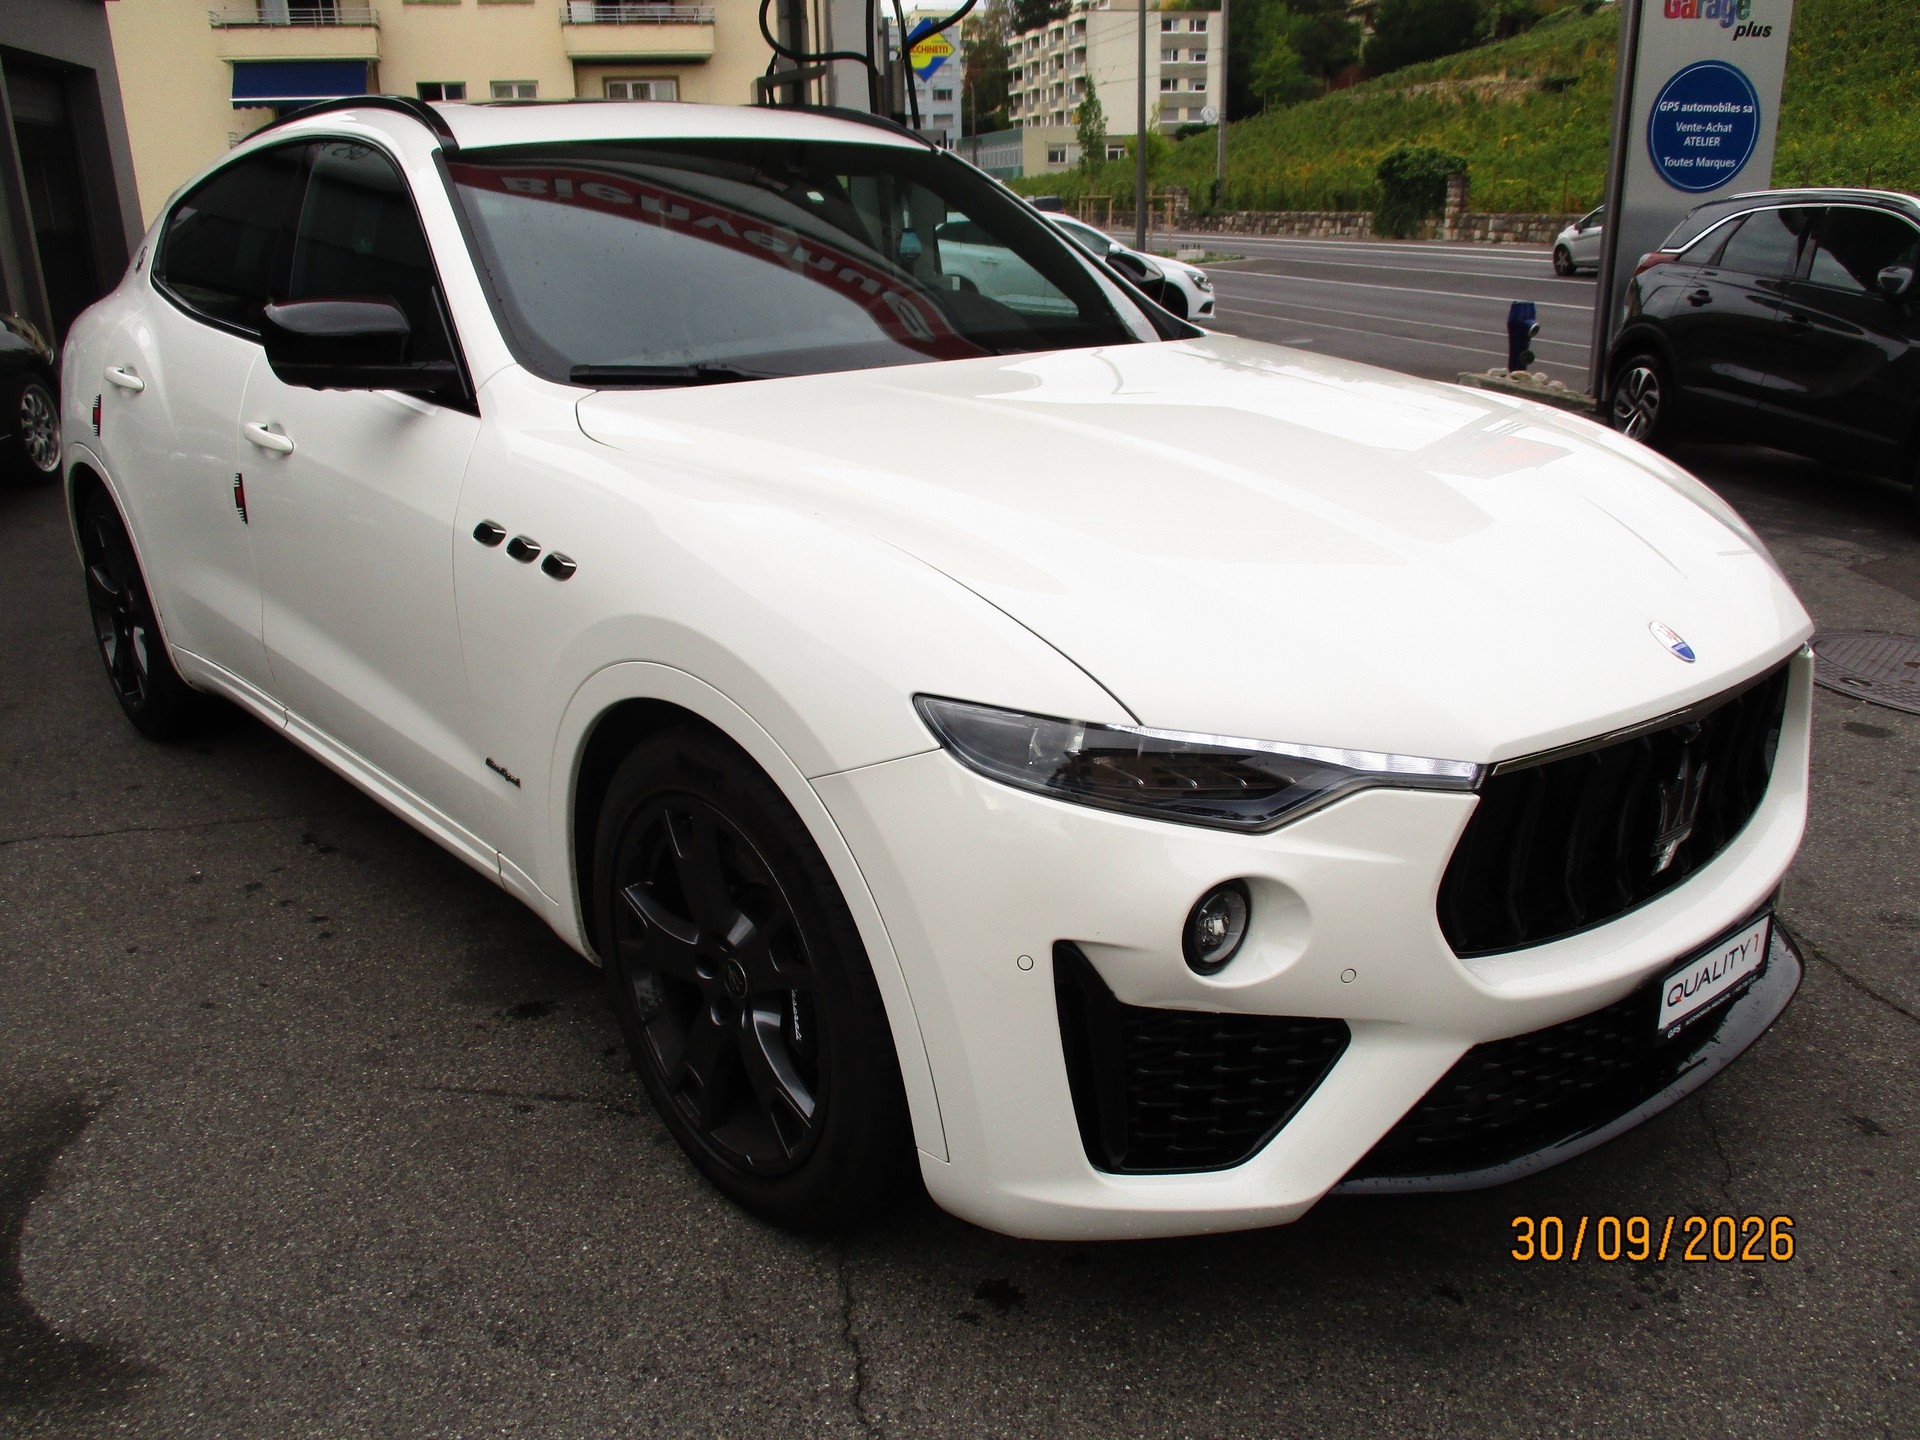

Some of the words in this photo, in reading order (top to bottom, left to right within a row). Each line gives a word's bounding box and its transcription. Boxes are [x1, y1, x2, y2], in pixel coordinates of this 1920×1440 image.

[1664, 0, 1751, 28] Garage
[1732, 21, 1772, 41] plus
[1660, 101, 1680, 112] GPS
[1681, 102, 1741, 113] automobiles
[1742, 105, 1753, 113] sa
[1676, 121, 1733, 132] Vente-Achat
[1683, 136, 1721, 147] ATELIER
[1664, 156, 1694, 167] Toutes
[1695, 157, 1736, 169] Marques
